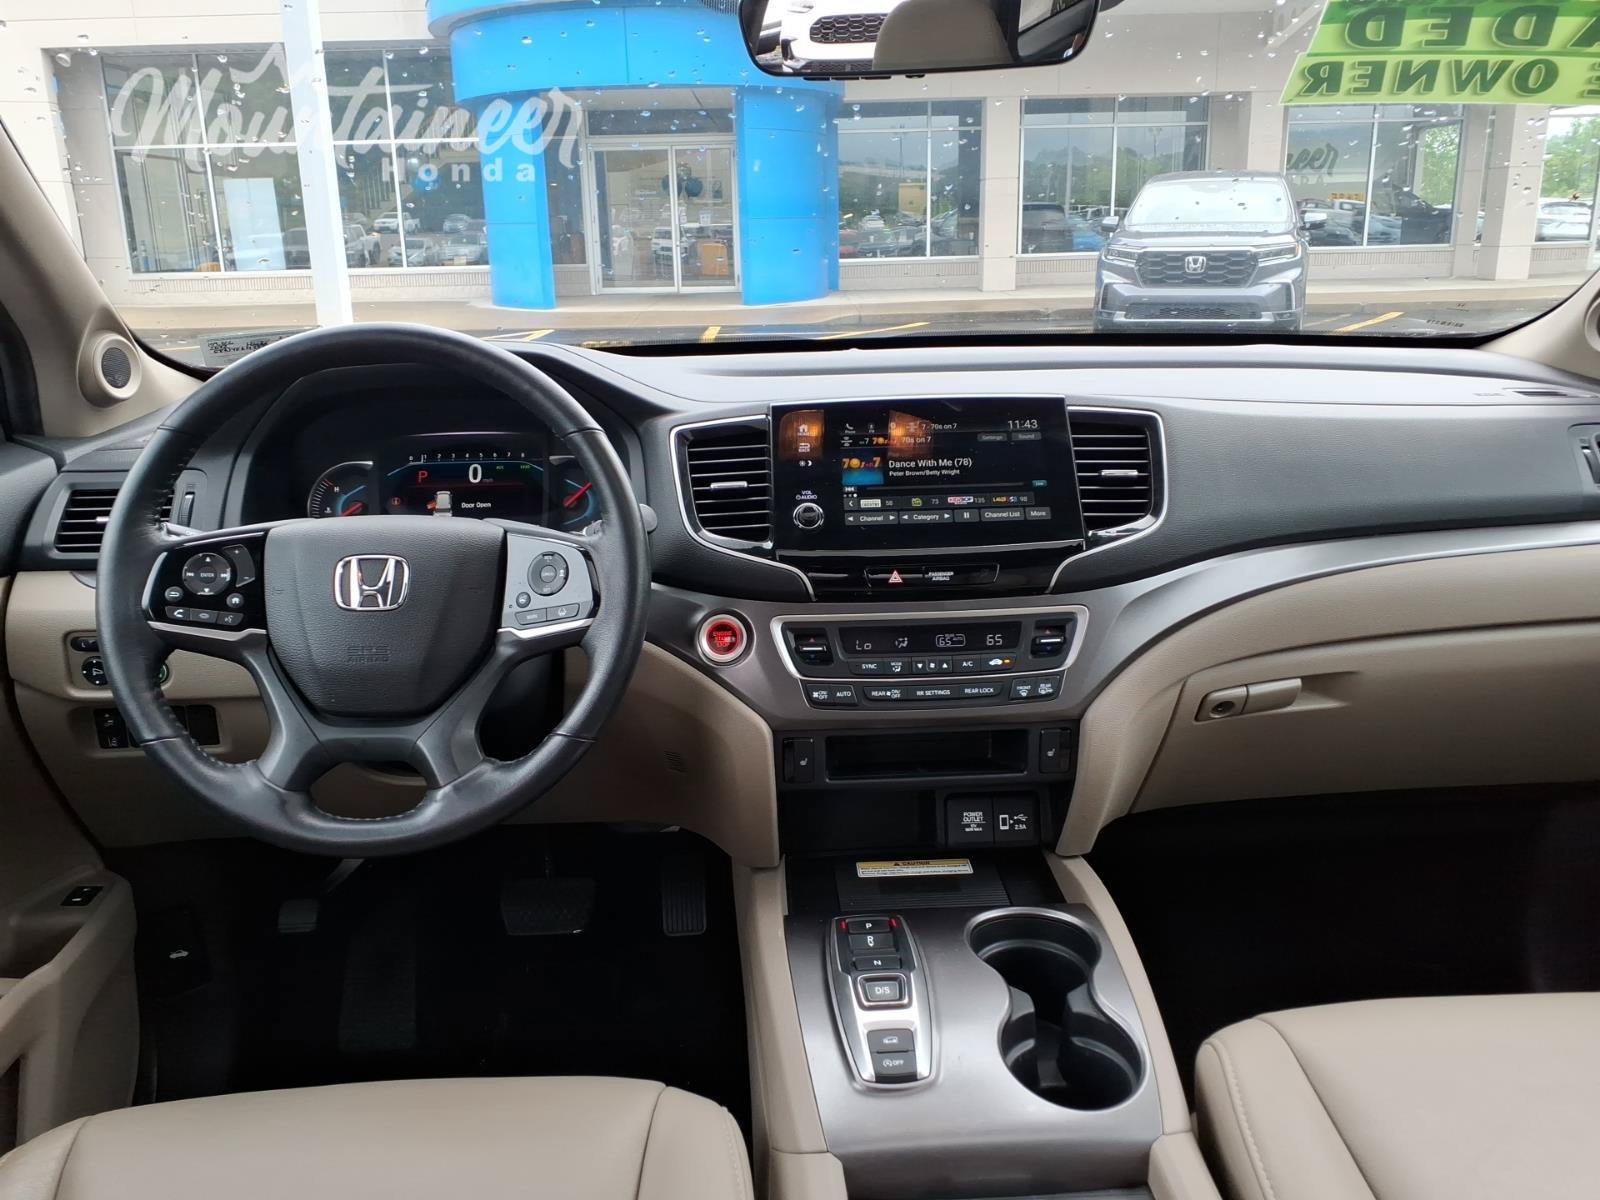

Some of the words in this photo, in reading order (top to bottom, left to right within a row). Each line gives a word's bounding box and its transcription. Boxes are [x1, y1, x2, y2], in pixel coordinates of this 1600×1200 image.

[1008, 419, 1038, 429] 11:43
[873, 456, 881, 467] 7
[889, 460, 916, 468] Dance
[917, 459, 937, 467] With
[938, 458, 953, 467] Me
[954, 458, 972, 468] (78)
[418, 470, 428, 482] P
[468, 463, 482, 484] 0
[476, 501, 492, 509] Open
[856, 640, 872, 650] Lo
[939, 637, 951, 646] 65
[986, 634, 1003, 646] 65
[875, 986, 890, 994] D/S
